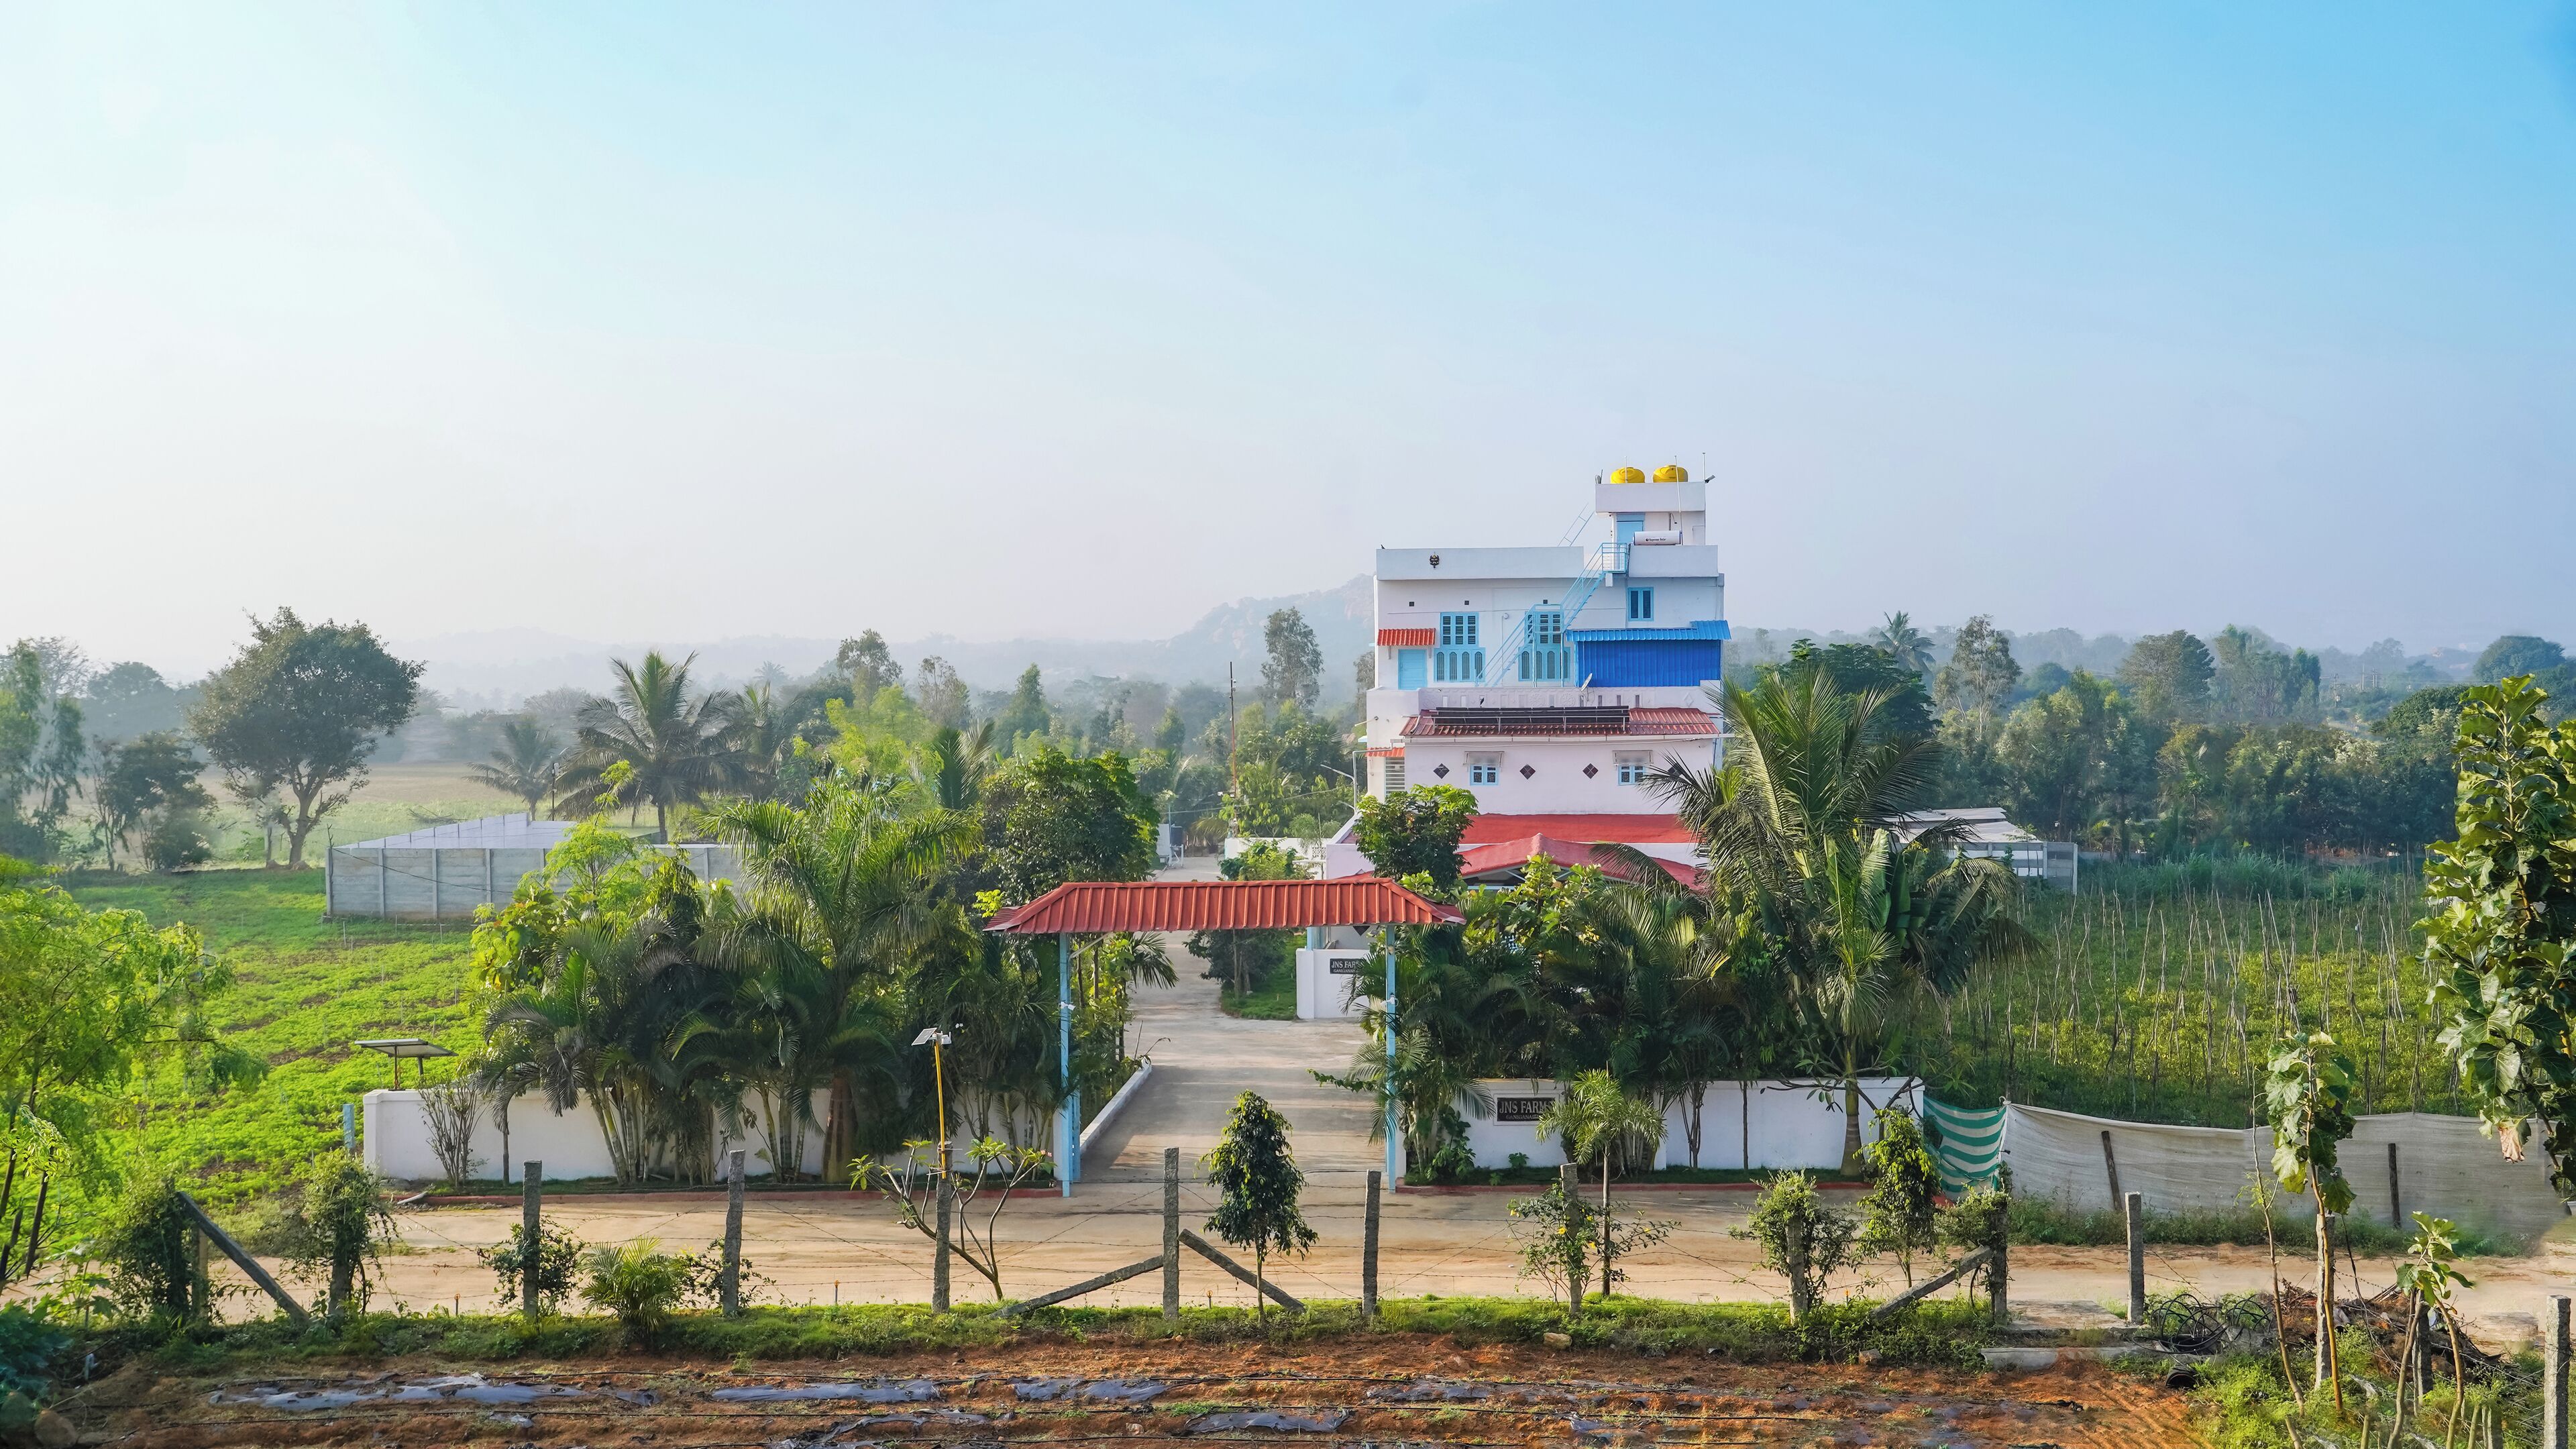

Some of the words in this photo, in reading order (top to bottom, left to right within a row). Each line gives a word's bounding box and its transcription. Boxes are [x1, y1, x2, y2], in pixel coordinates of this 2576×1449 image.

[1332, 961, 1343, 969] JNS
[1344, 961, 1360, 969] FAR
[1499, 1101, 1518, 1114] JNS
[1520, 1101, 1552, 1114] FARM
